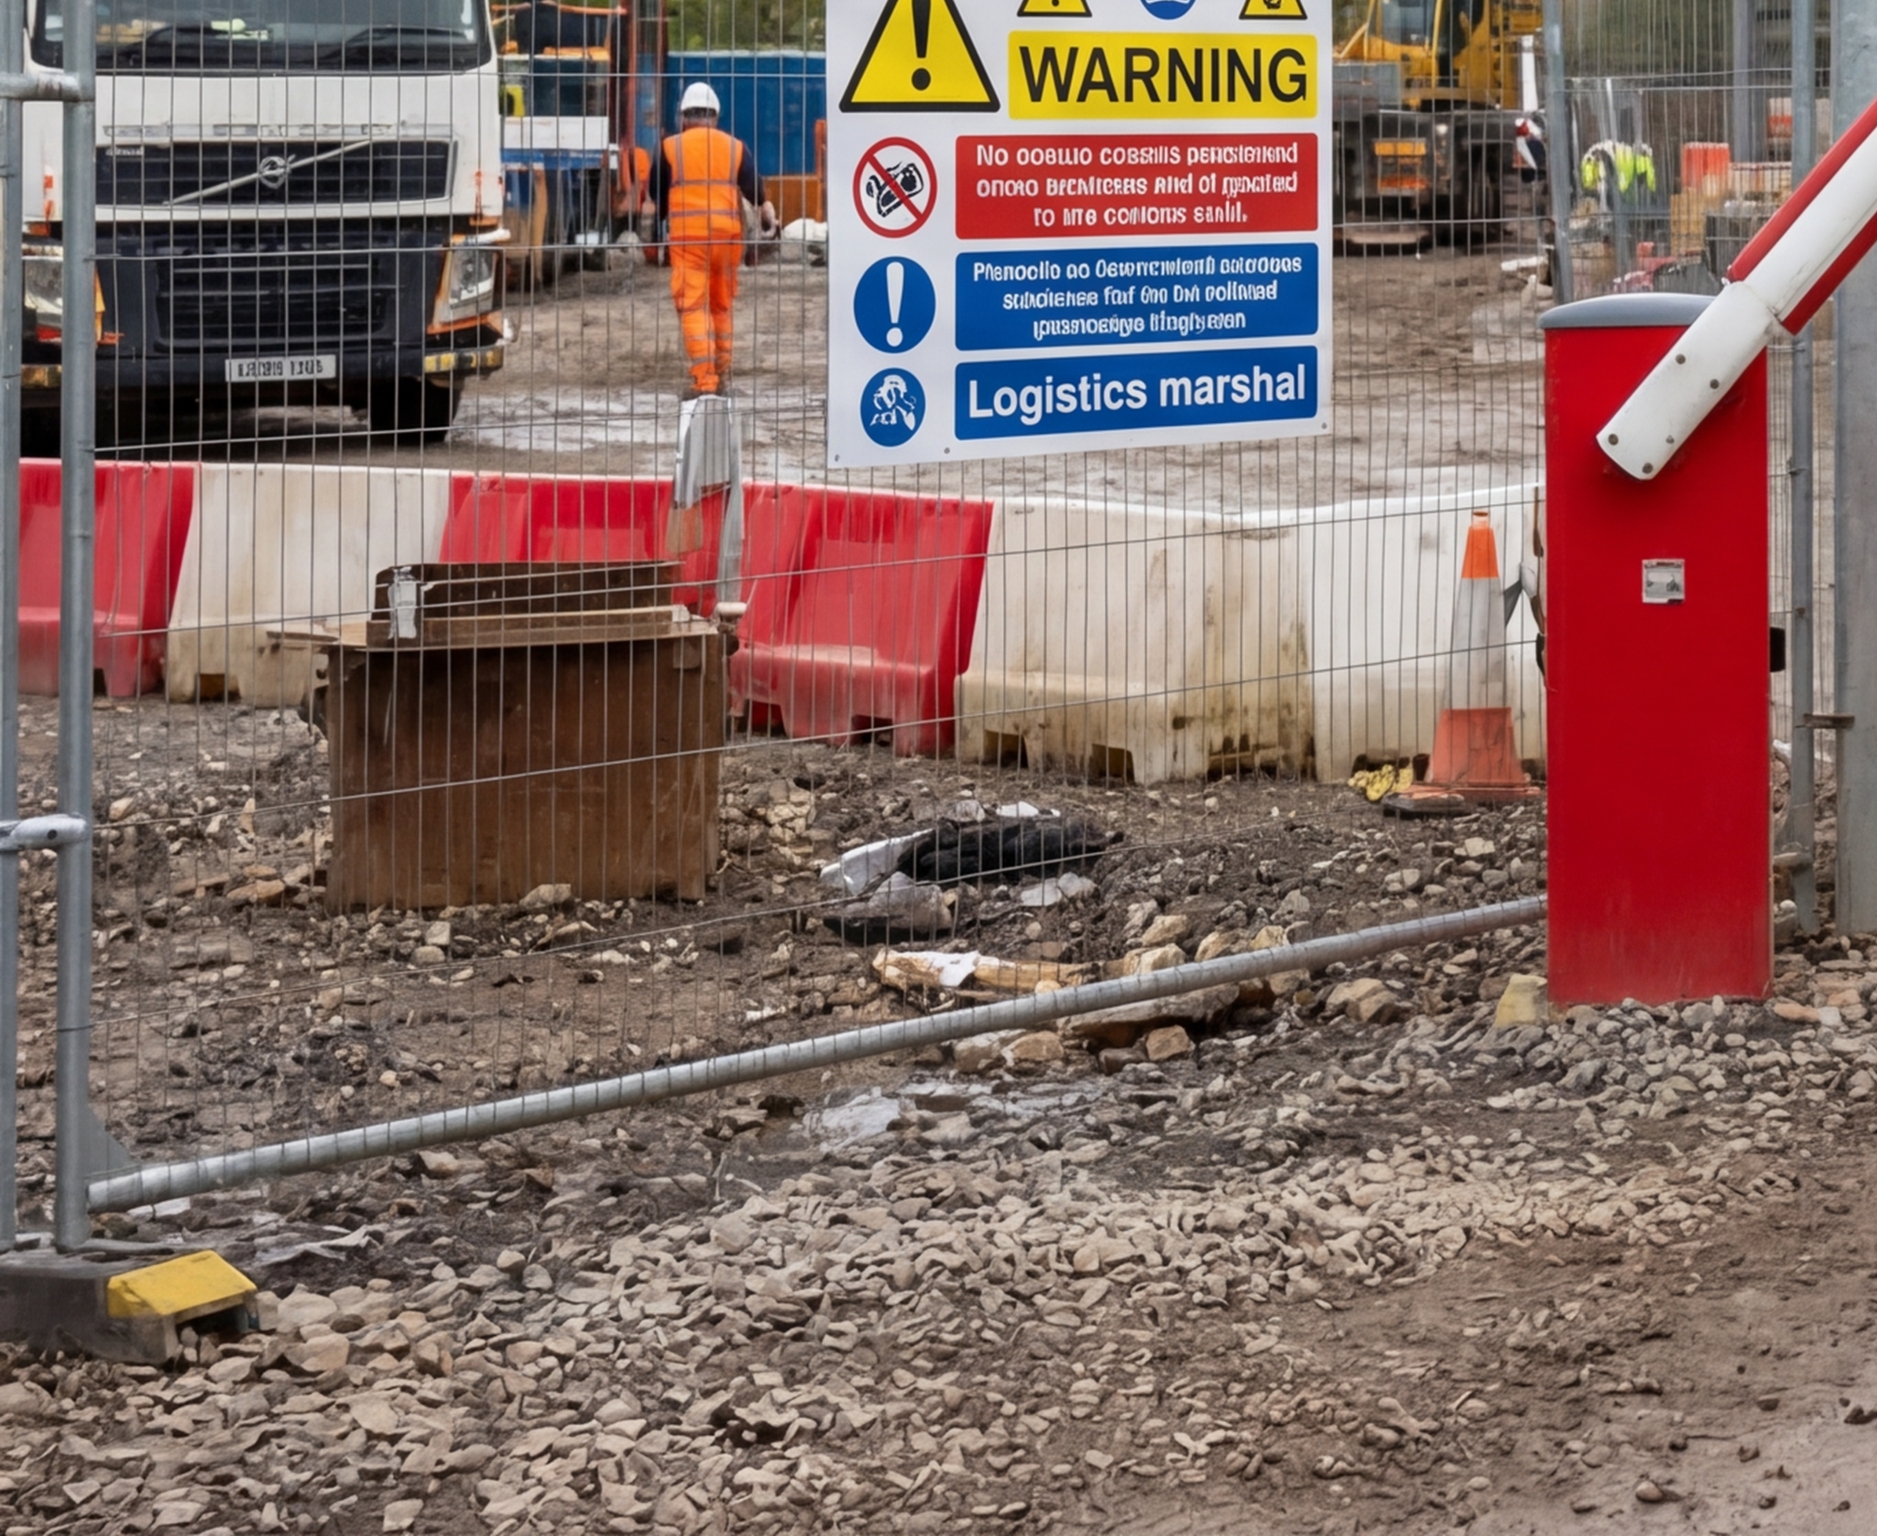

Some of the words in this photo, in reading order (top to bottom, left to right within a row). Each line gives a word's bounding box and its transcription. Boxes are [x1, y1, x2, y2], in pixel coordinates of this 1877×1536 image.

[1019, 46, 1307, 103] WARNING
[977, 144, 1009, 166] No
[969, 373, 1147, 425] Logistics
[1159, 364, 1305, 407] marshal
